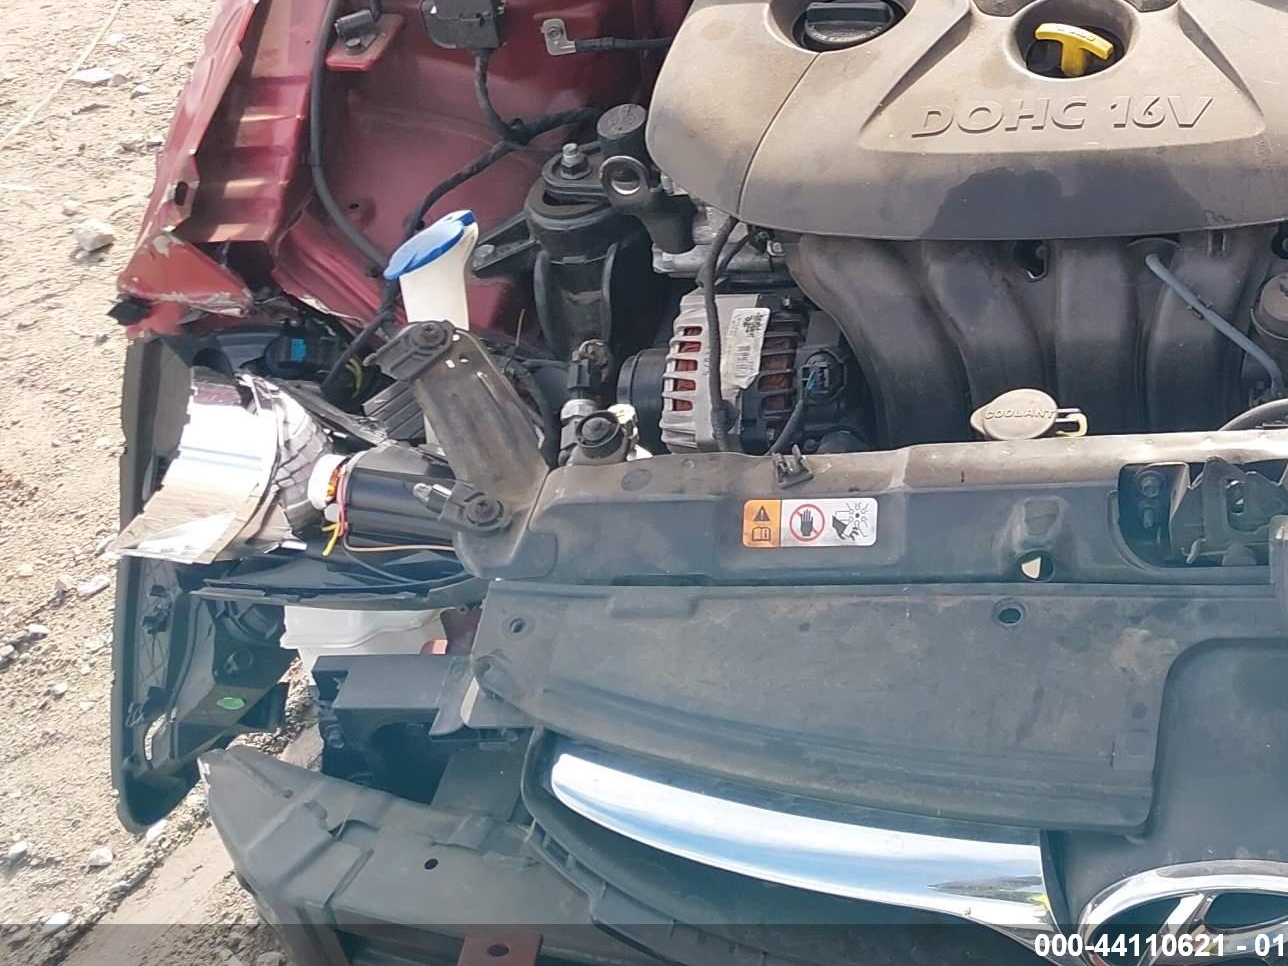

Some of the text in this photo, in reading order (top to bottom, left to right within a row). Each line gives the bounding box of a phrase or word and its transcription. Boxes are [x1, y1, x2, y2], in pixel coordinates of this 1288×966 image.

[911, 95, 1216, 138] DOHC 16V
[984, 408, 1056, 420] COOLANT
